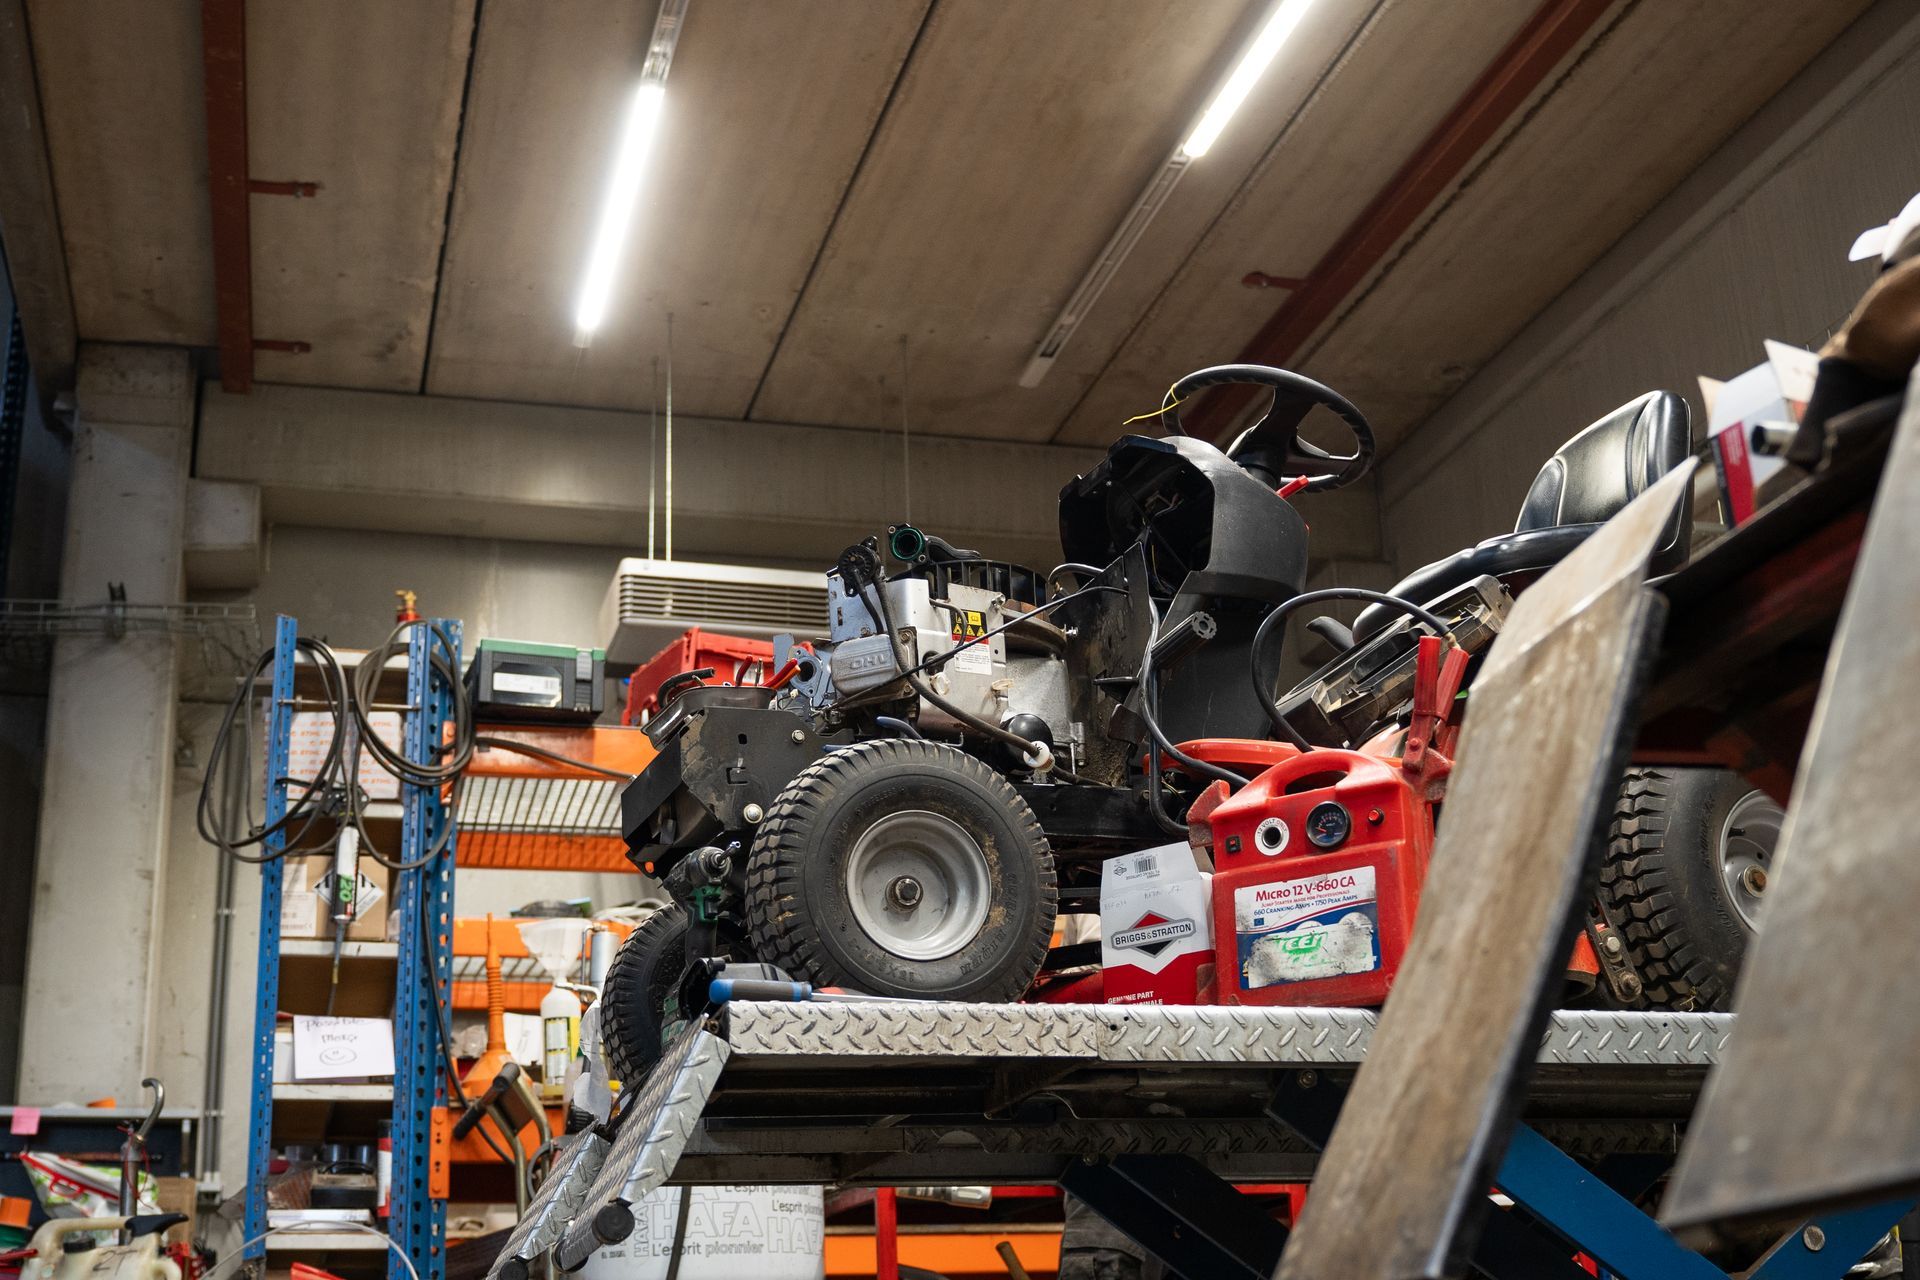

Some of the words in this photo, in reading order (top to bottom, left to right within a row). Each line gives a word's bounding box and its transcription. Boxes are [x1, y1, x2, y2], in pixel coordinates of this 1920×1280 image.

[1293, 884, 1304, 896] 12
[1340, 875, 1356, 888] CA
[1136, 991, 1154, 1000] PART
[772, 1200, 802, 1215] L'esprit
[652, 1201, 764, 1240] HAFA
[633, 1205, 650, 1258] HAFA
[652, 1242, 702, 1257] L'eprit
